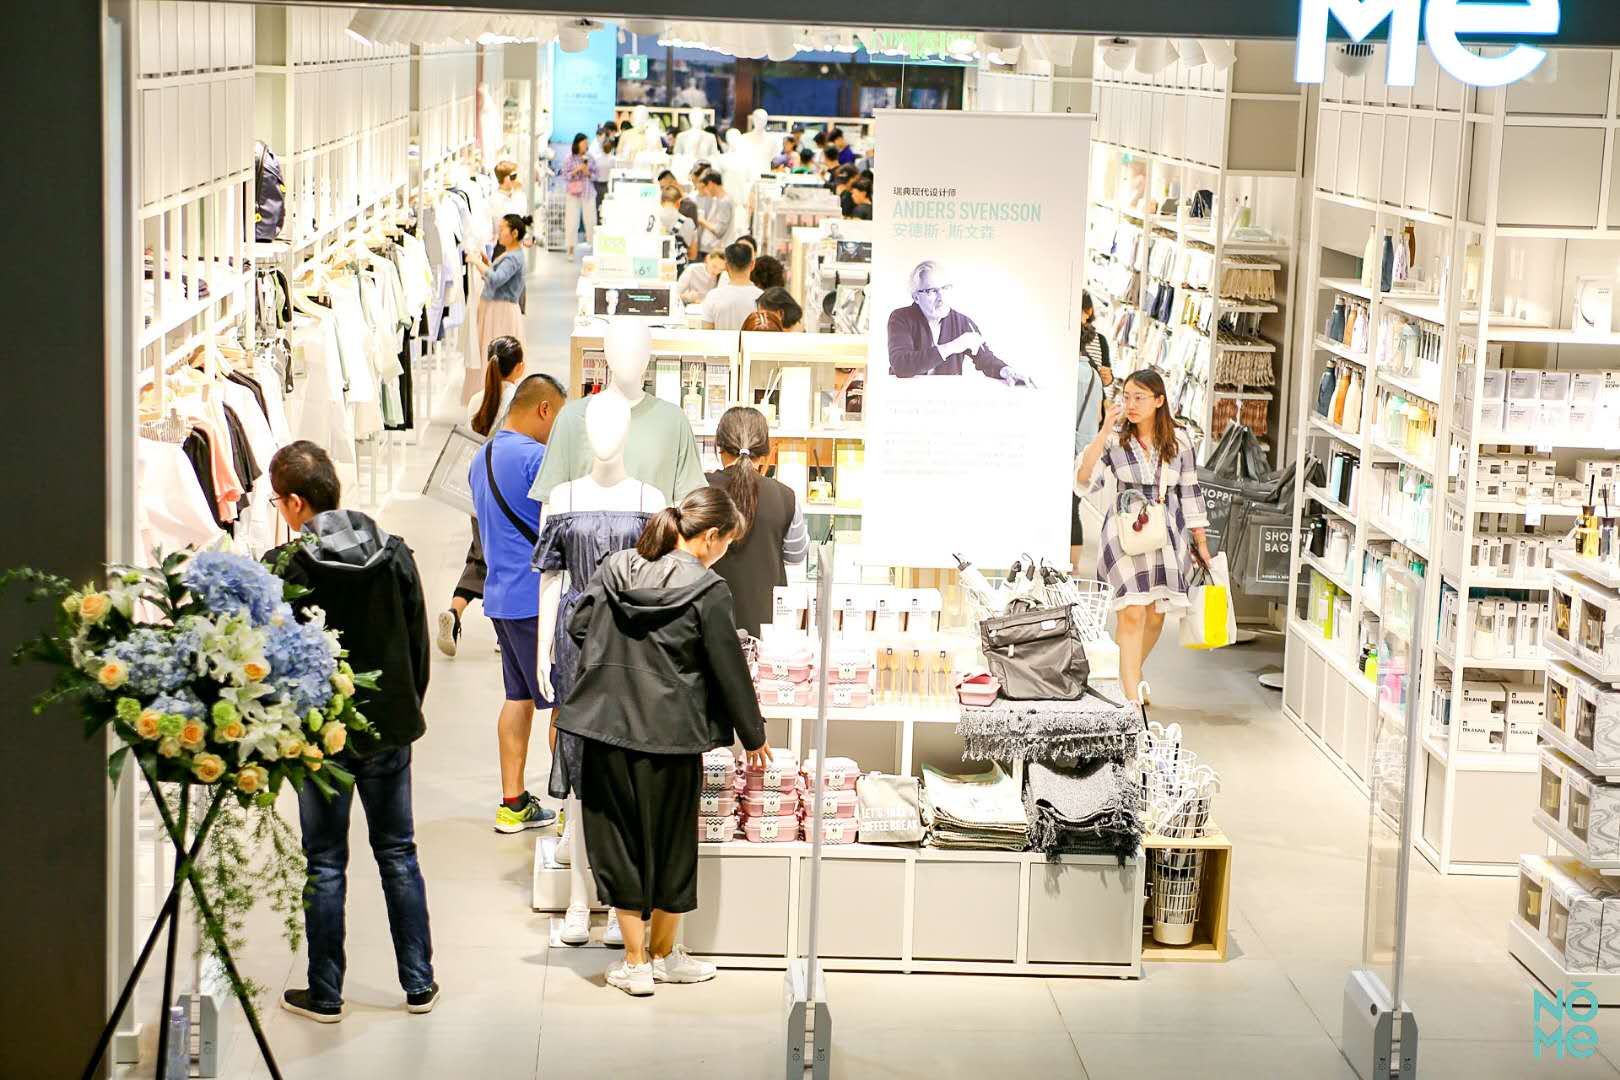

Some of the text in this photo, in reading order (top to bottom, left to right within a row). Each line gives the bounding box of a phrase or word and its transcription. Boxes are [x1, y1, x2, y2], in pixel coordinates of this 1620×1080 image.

[893, 186, 957, 197] 瑞典现代设计师
[893, 200, 1041, 223] ANDERS SVENSSON
[1264, 543, 1289, 553] BAG
